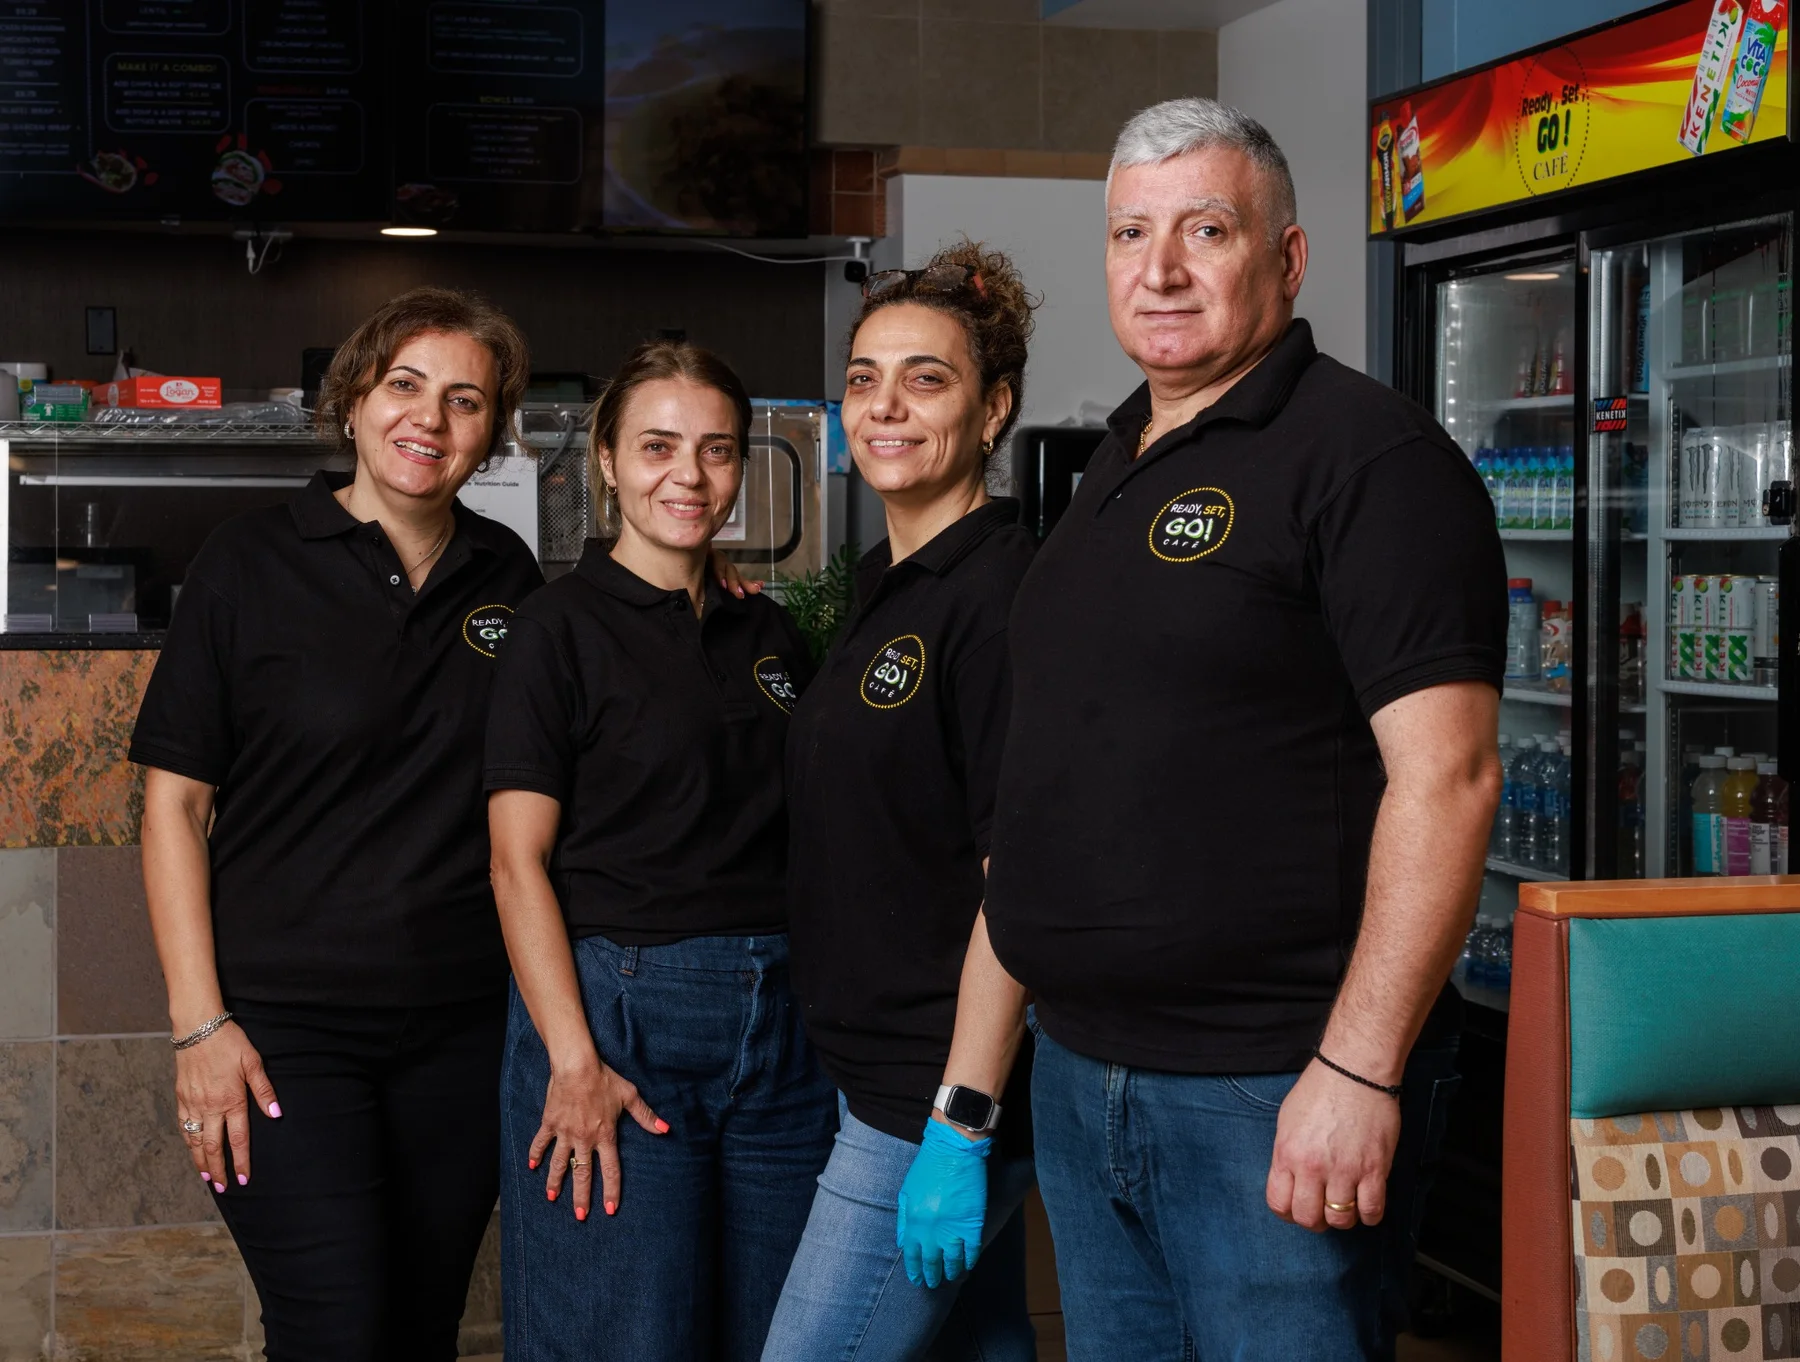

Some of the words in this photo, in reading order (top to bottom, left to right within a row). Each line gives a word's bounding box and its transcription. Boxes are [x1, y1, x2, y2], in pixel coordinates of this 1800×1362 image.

[1747, 37, 1766, 63] VITA
[117, 61, 147, 71] MAKE
[165, 385, 195, 397] Logan
[1596, 409, 1626, 420] KENETIK
[1170, 503, 1202, 516] READY,
[1203, 505, 1226, 518] SET,
[1165, 517, 1214, 542] GO!
[472, 618, 506, 628] READY,
[900, 655, 919, 671] SET,
[874, 662, 908, 690] GO!
